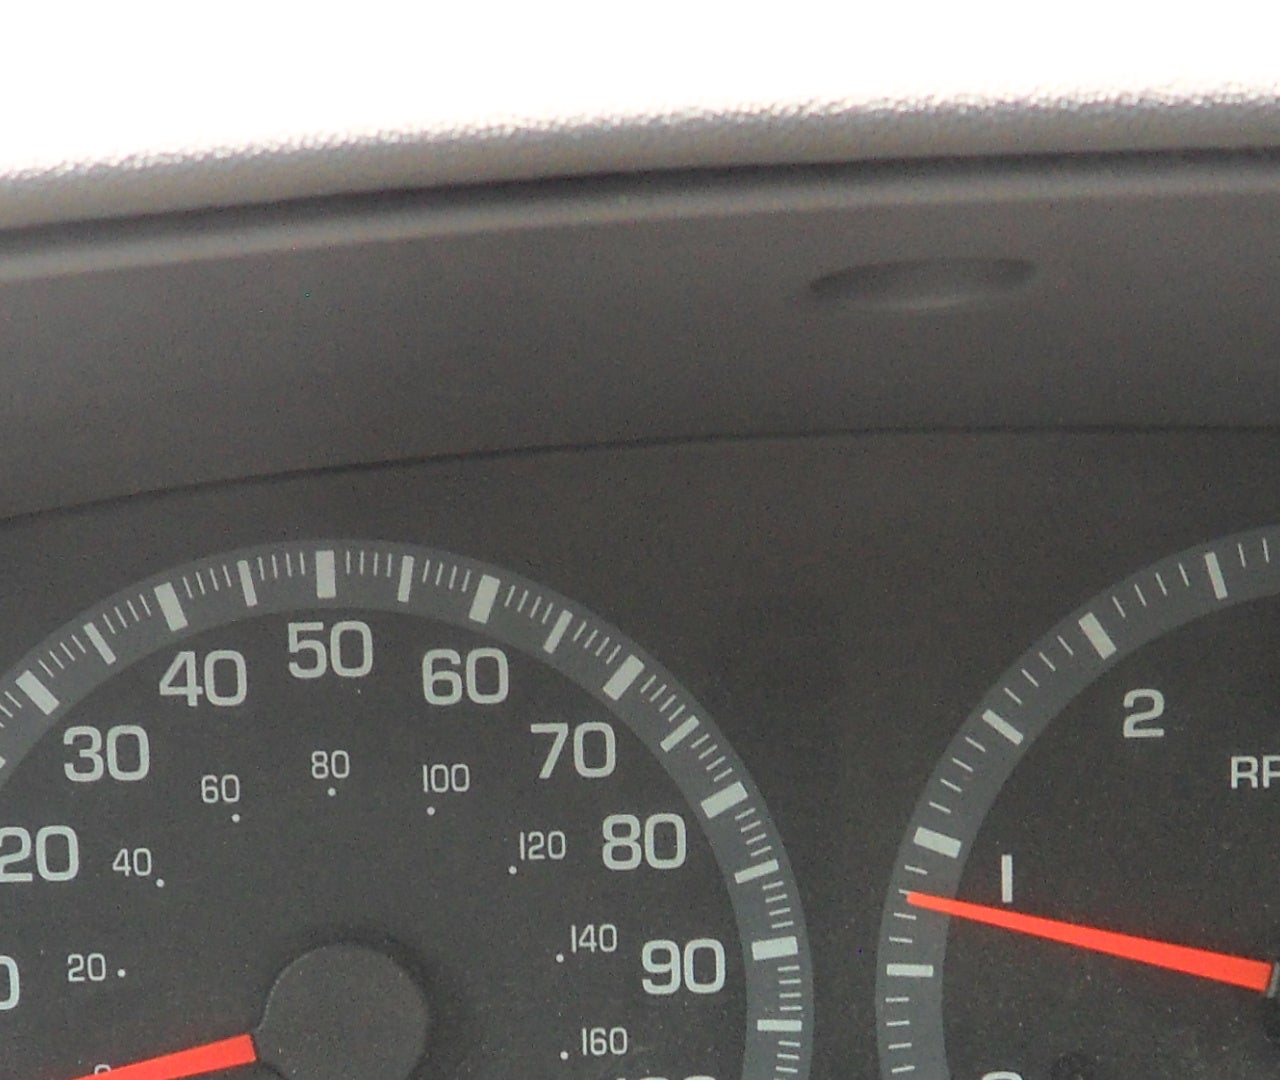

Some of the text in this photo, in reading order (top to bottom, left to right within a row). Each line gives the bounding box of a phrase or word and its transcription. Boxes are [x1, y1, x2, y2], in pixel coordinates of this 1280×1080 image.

[287, 620, 374, 679] 50
[159, 649, 248, 707] 40
[422, 647, 509, 706] 60
[1123, 688, 1165, 738] 2
[63, 725, 150, 783] 30
[311, 749, 350, 780] 80
[530, 721, 616, 779] 70
[201, 774, 240, 804] 60
[422, 763, 470, 793] 100
[112, 847, 152, 877] 40
[519, 830, 567, 860] 120
[602, 813, 687, 871] 80
[1001, 854, 1013, 904] 1
[571, 923, 618, 953] 140
[67, 952, 107, 982] 20
[641, 938, 726, 995] 90
[581, 1026, 628, 1056] 160
